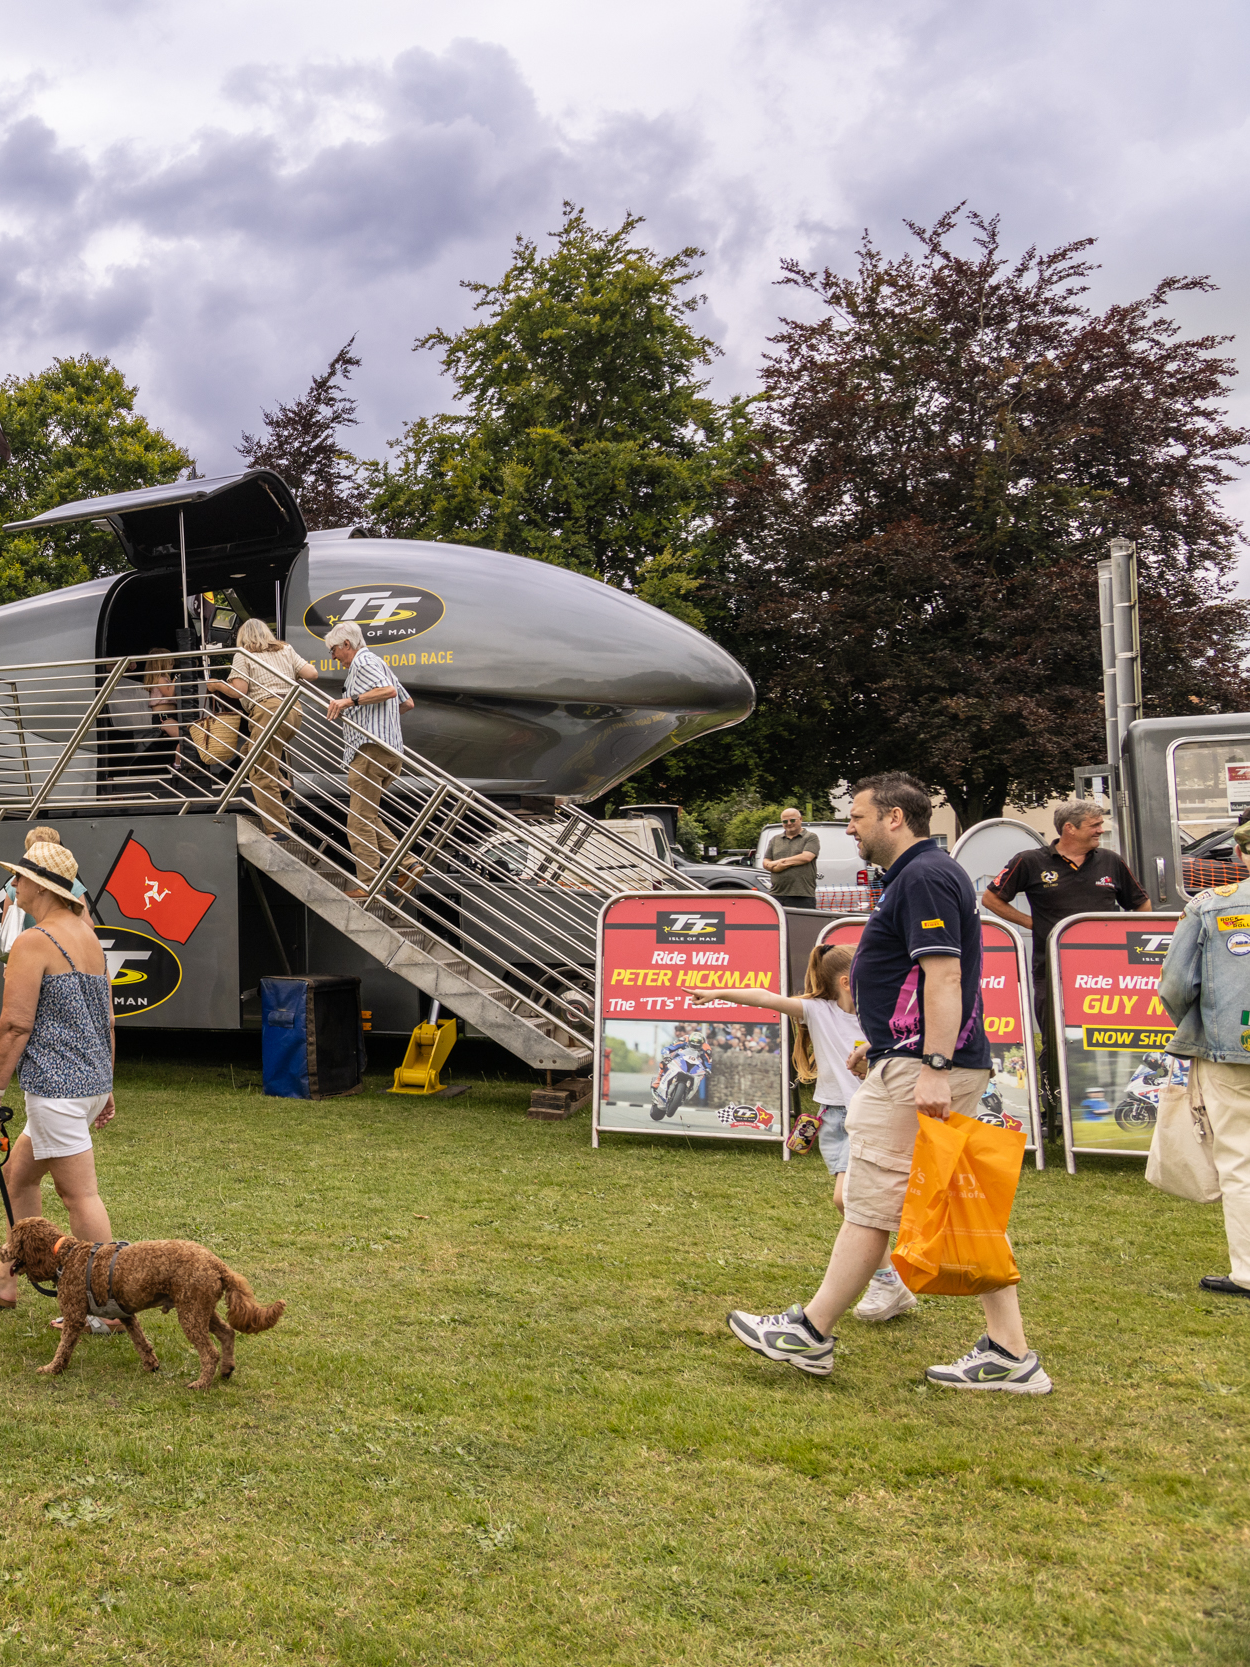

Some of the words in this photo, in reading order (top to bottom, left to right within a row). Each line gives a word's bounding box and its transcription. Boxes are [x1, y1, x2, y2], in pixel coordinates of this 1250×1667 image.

[338, 591, 422, 627] TT
[383, 653, 416, 667] ROAD
[421, 651, 454, 665] RACE
[669, 914, 719, 935] TT
[1141, 934, 1174, 951] T
[651, 951, 687, 965] Ride
[692, 951, 730, 966] With
[610, 968, 671, 986] PETER
[676, 970, 772, 988] HICKMAN
[981, 976, 1005, 988] rld
[1075, 974, 1113, 989] Ride
[1118, 975, 1160, 990] With
[114, 997, 148, 1006] MAN
[608, 998, 635, 1011] The
[1083, 994, 1139, 1015] GUY
[1092, 1031, 1135, 1044] NOW
